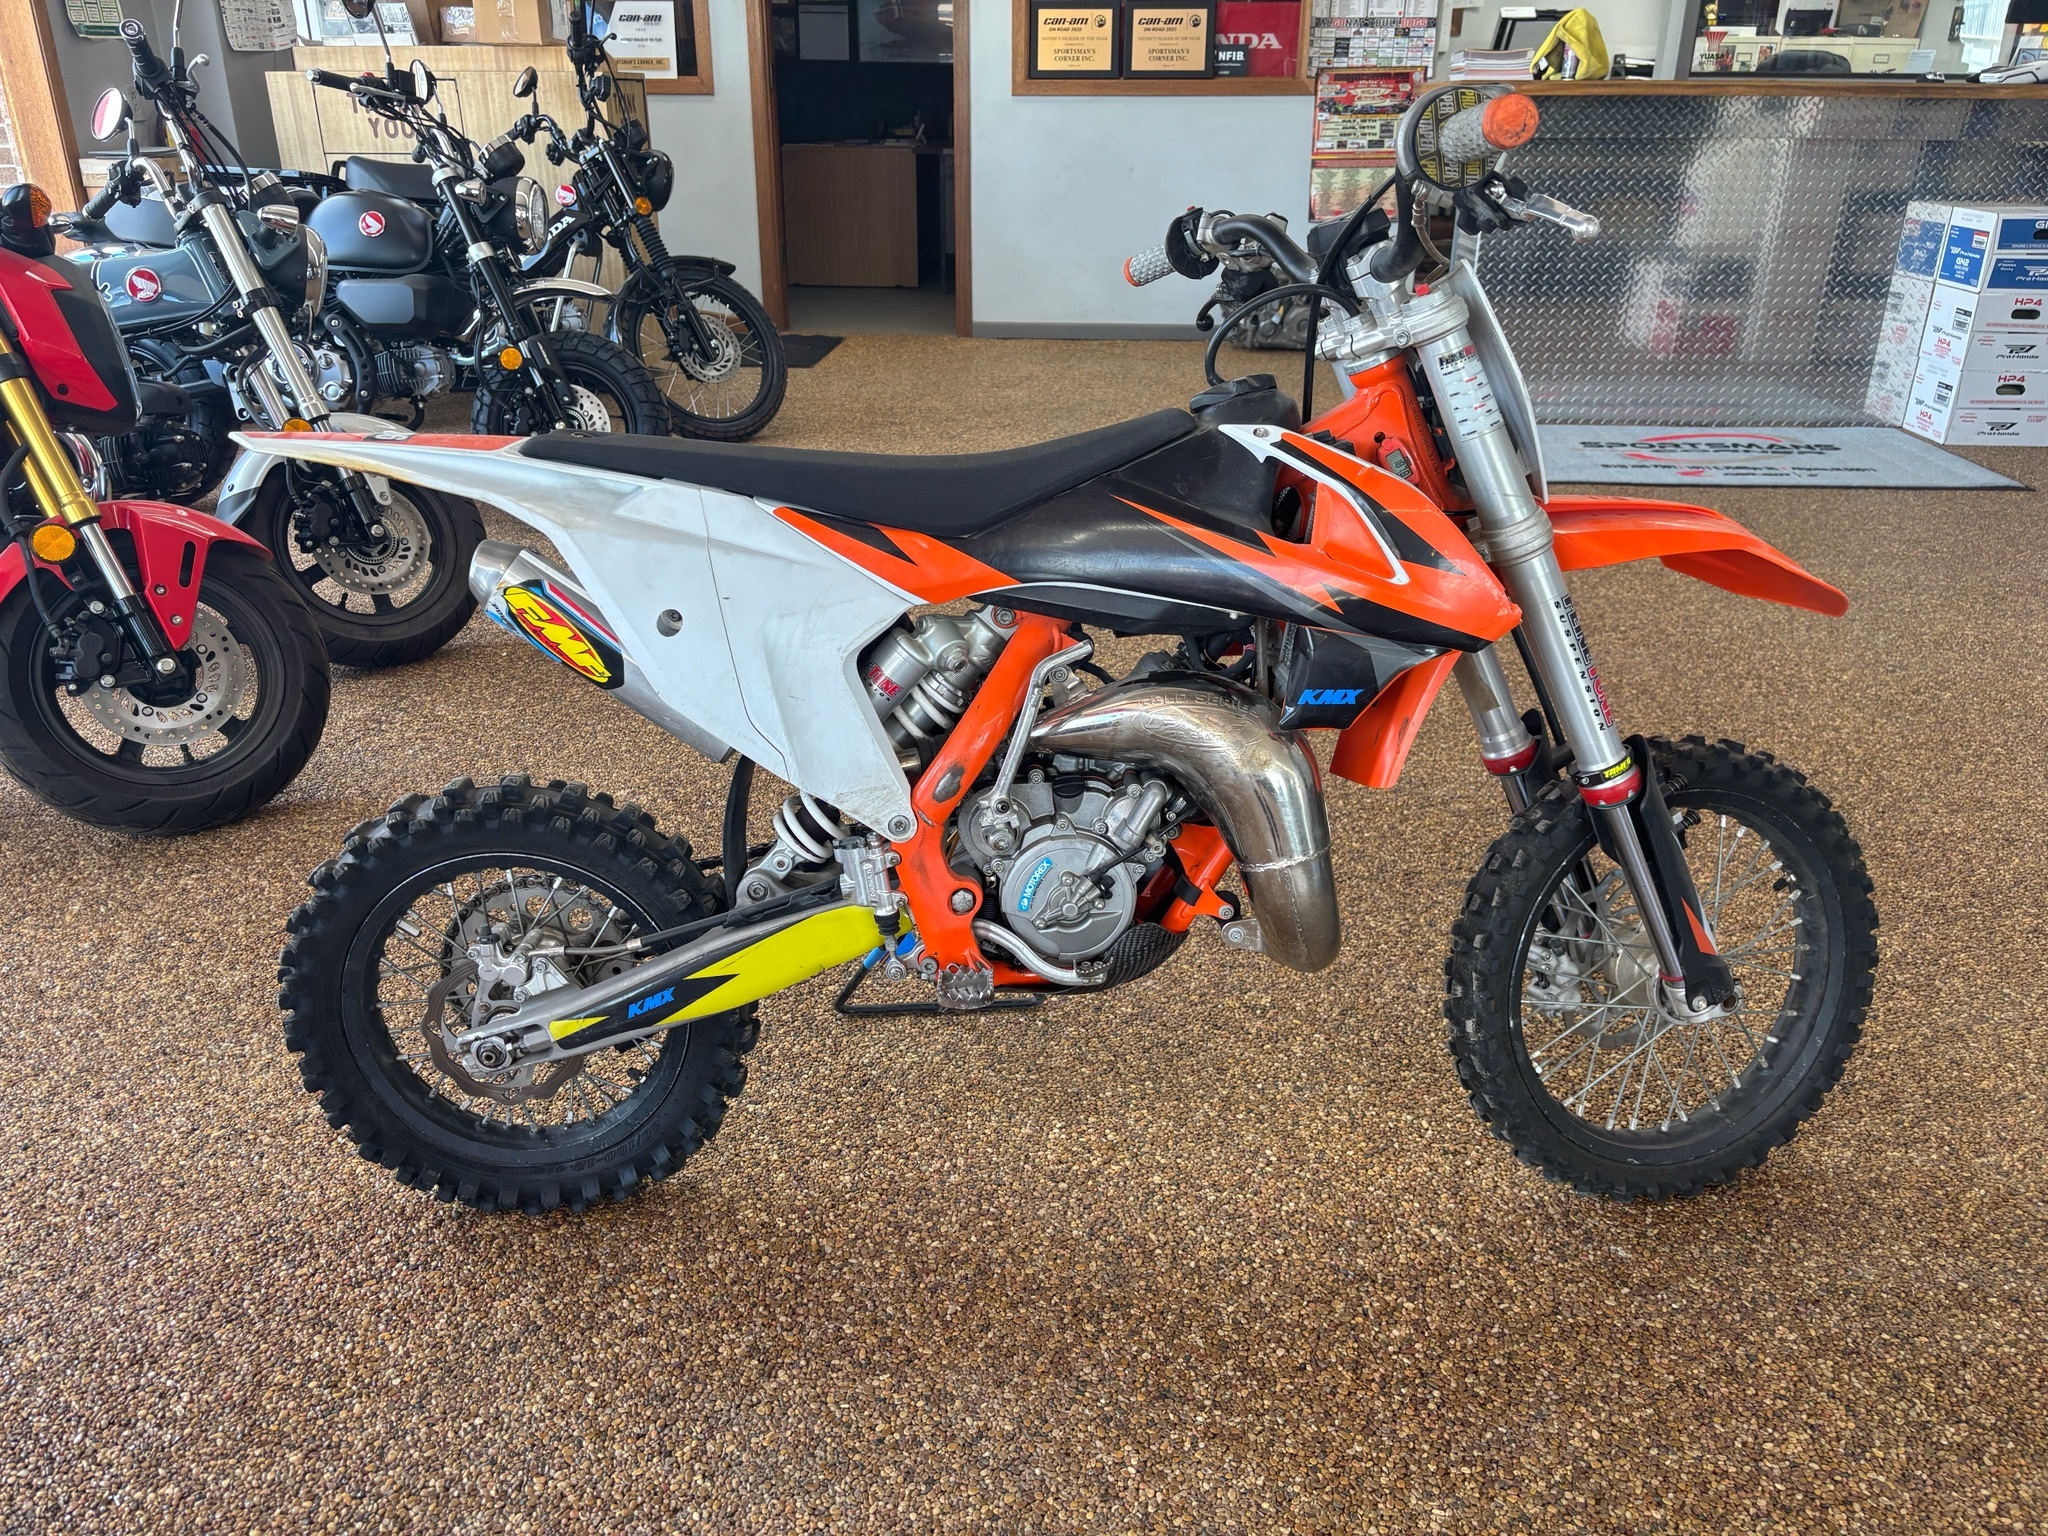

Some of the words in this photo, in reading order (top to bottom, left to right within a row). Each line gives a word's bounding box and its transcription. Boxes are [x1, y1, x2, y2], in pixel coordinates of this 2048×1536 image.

[618, 14, 662, 22] can-am
[1043, 17, 1089, 26] can-am
[1138, 17, 1184, 26] can-am
[2014, 297, 2043, 307] HP4
[1997, 374, 2026, 383] HP4
[1579, 441, 1842, 451] SPORTSMANS
[502, 592, 613, 678] FMF
[1297, 689, 1365, 705] KMX
[1023, 861, 1051, 899] MOTOREX
[627, 986, 676, 1020] KMX
